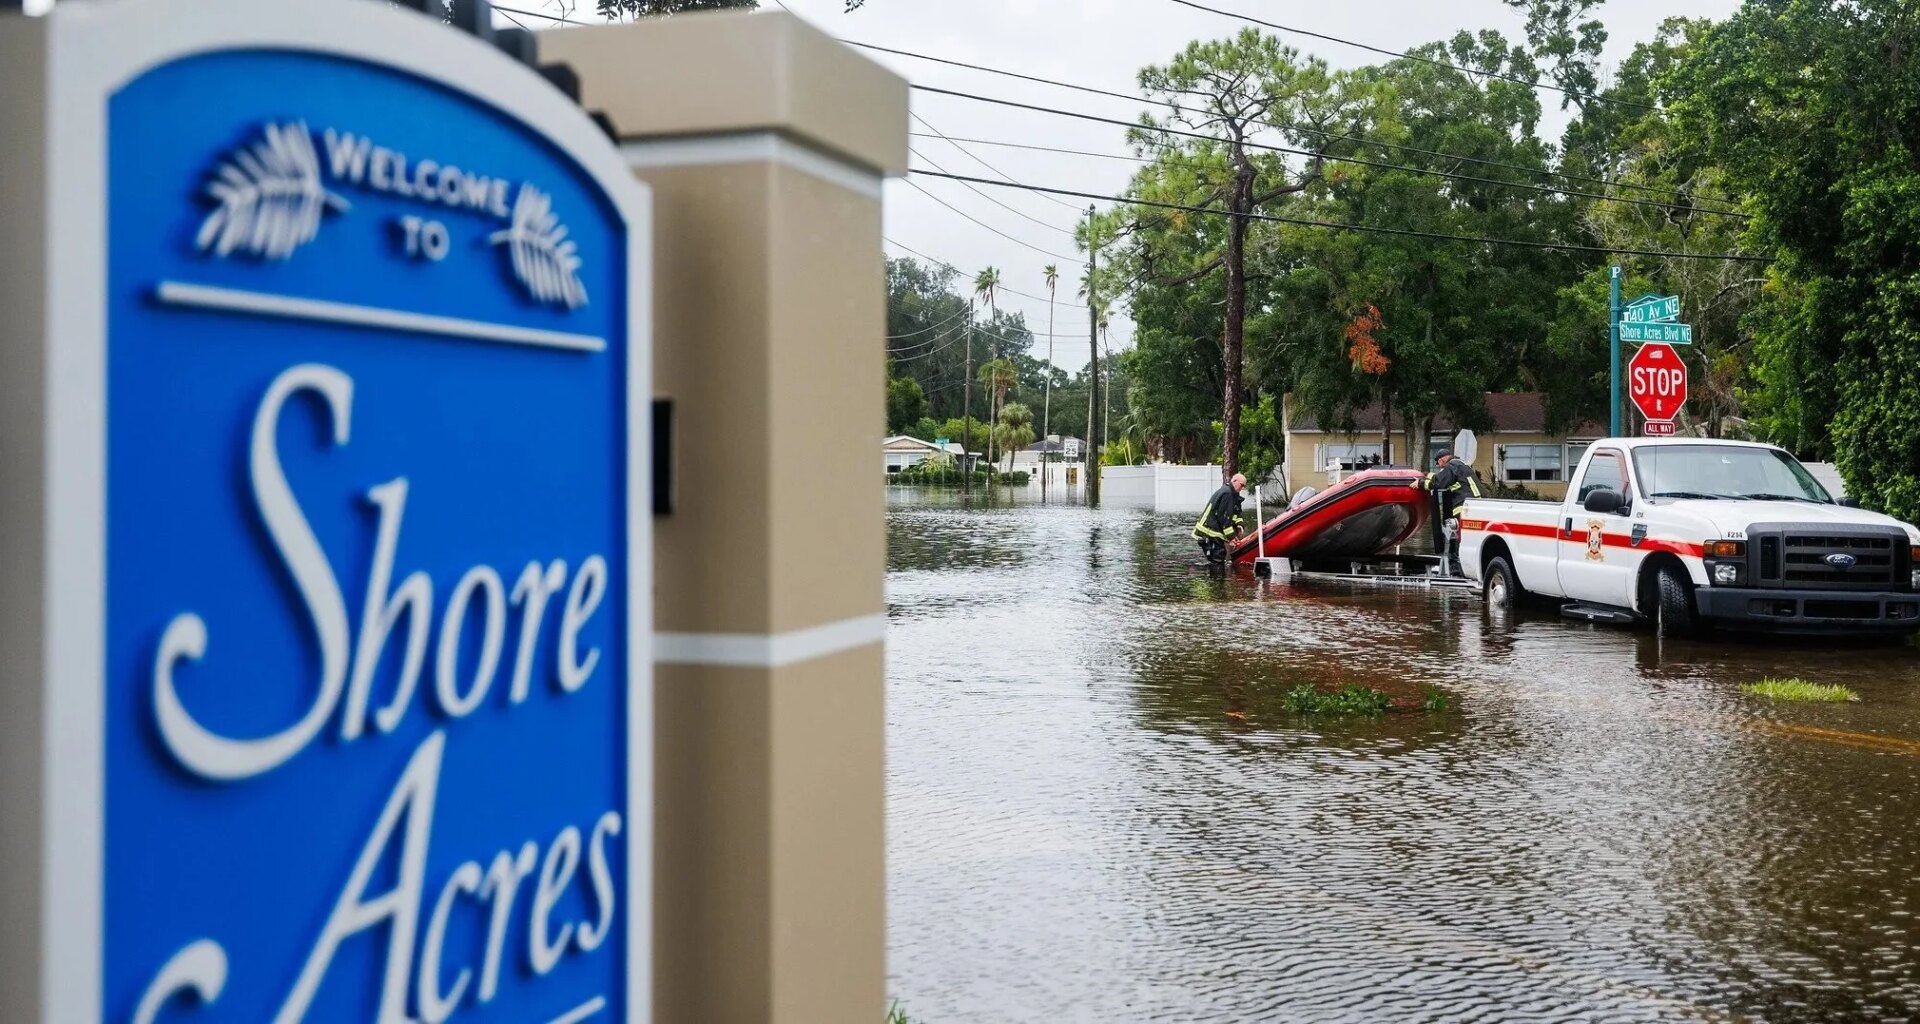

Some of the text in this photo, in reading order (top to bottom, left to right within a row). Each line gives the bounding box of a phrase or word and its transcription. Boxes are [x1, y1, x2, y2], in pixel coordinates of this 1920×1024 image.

[323, 127, 511, 217] WELCOME
[401, 213, 451, 263] TO
[1630, 298, 1678, 322] 40 Av NE
[1621, 324, 1691, 342] Shore Acres Blvd NE
[1634, 366, 1683, 396] STOP
[1647, 424, 1672, 433] ALL WAY
[1065, 447, 1077, 455] 25
[153, 363, 607, 780] Shore
[134, 729, 621, 1024] Acres
